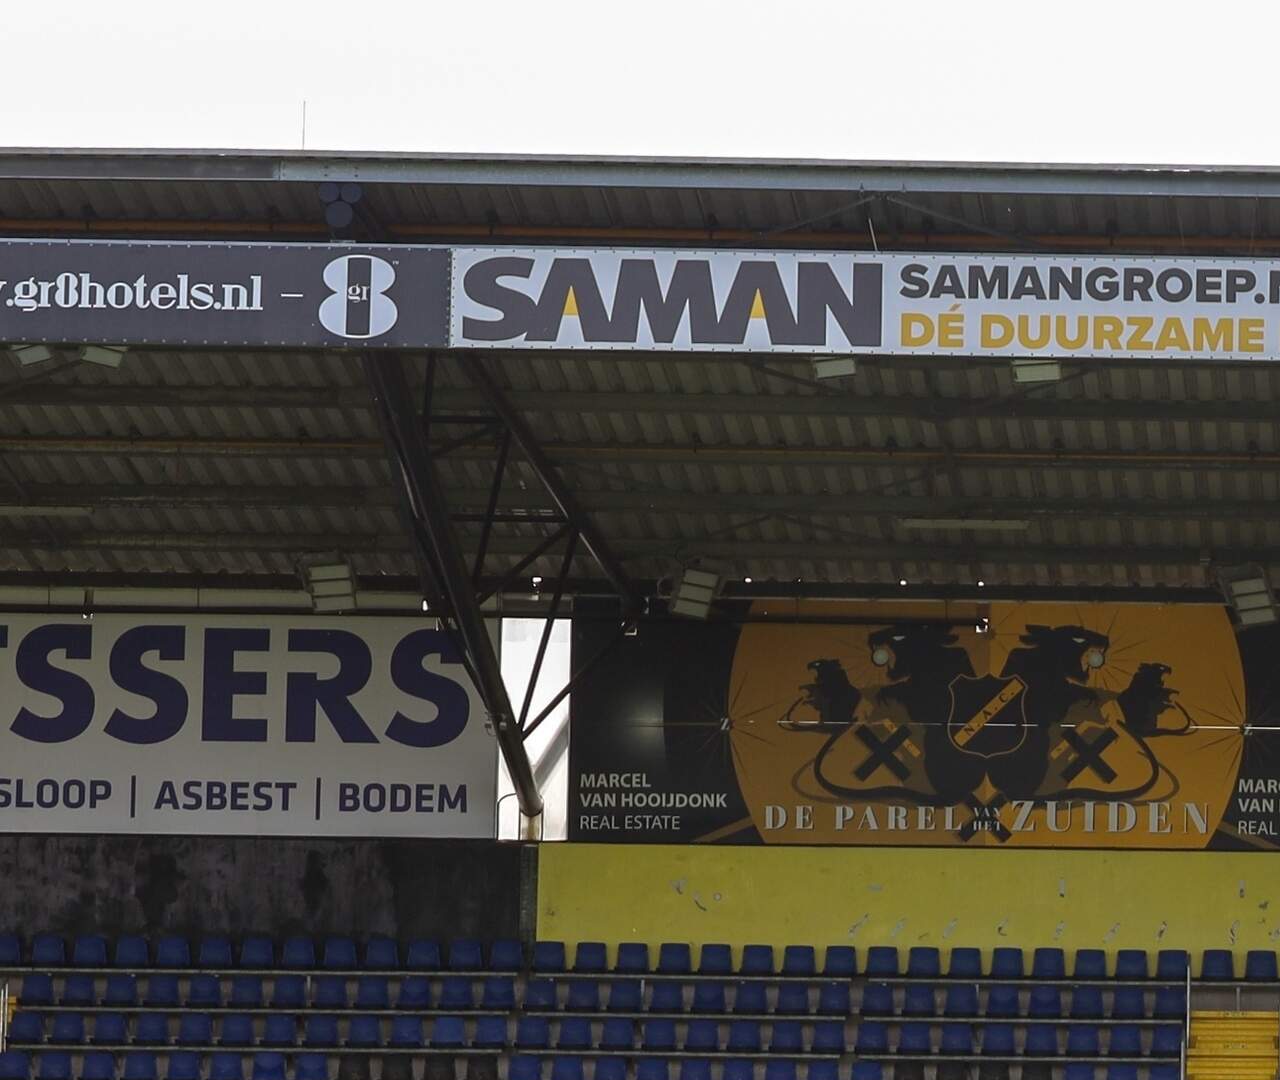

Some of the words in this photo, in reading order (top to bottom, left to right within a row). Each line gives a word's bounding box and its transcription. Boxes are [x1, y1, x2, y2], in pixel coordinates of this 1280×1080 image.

[0, 272, 264, 312] .gr8hotels.nl
[461, 255, 883, 347] SAMAN
[900, 303, 966, 347] DÉ
[980, 313, 1265, 353] DUURZAME
[0, 622, 471, 749] SSERS
[579, 773, 651, 788] MARCEL
[154, 780, 297, 812] ASBEST
[338, 782, 468, 814] BODEM
[579, 793, 617, 808] VAN
[621, 793, 728, 808] HOOIJDONK
[1238, 798, 1274, 814] VAN
[579, 815, 620, 830] REAL
[624, 815, 681, 830] ESTATE
[764, 805, 815, 830] DE
[834, 805, 963, 832] PAREL
[1011, 799, 1209, 834] ZUIDEN
[1237, 820, 1278, 836] REAL
